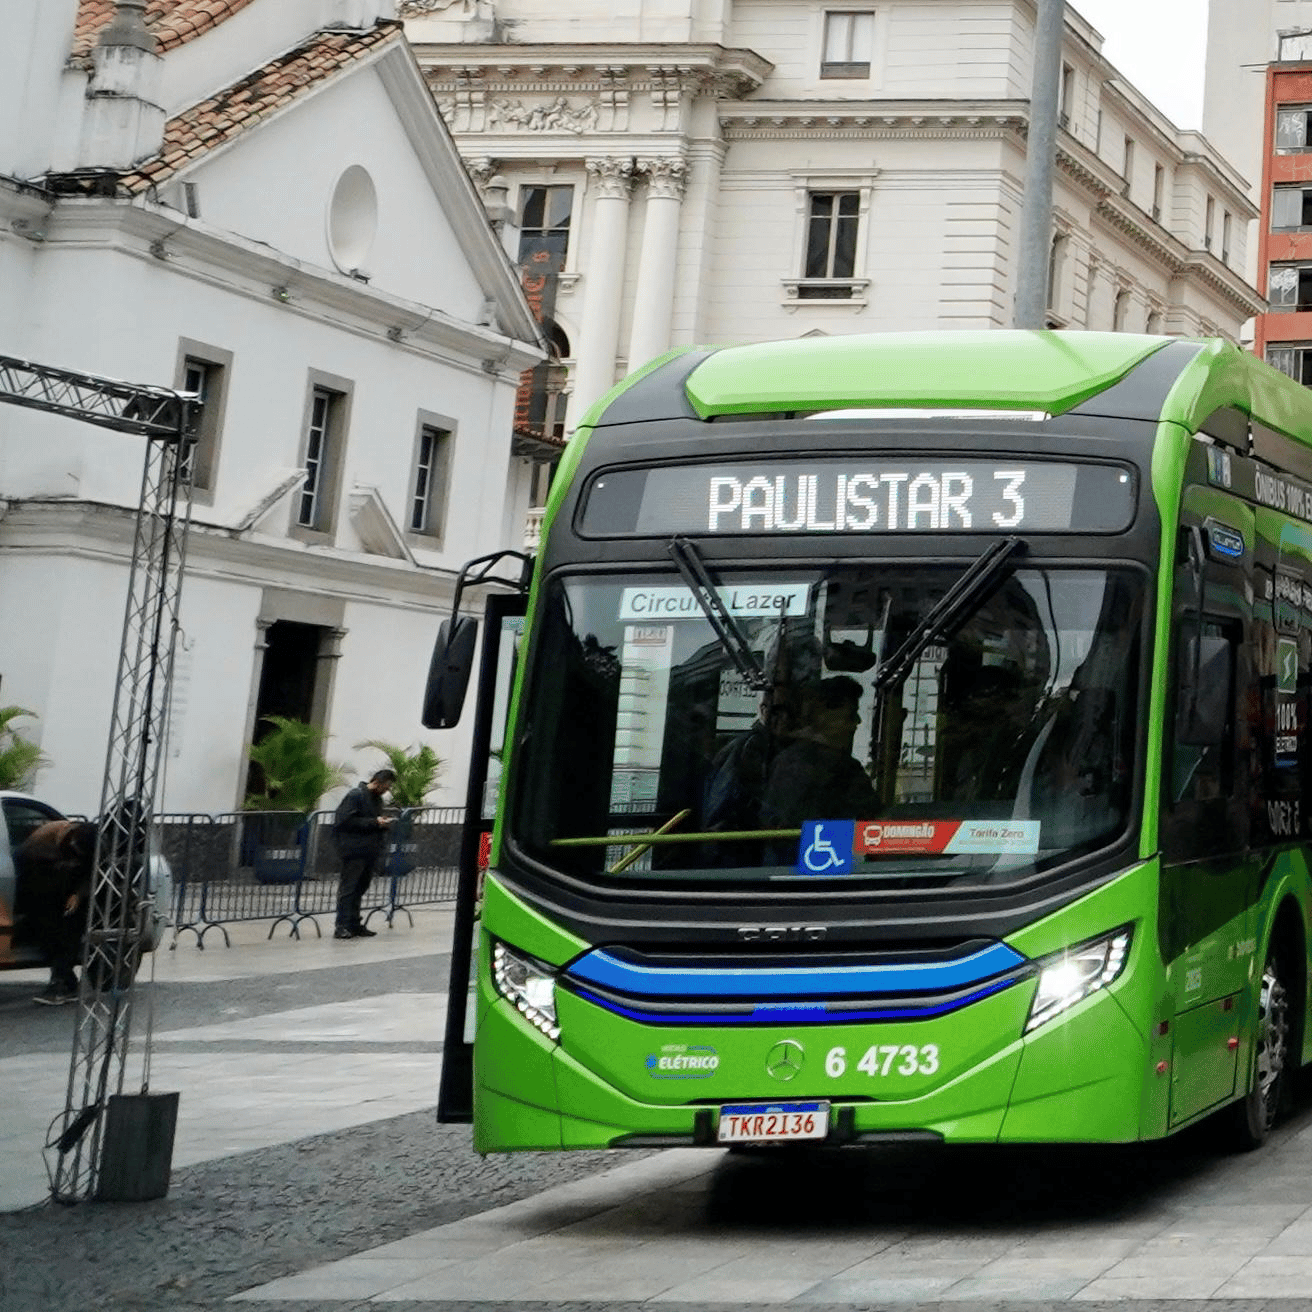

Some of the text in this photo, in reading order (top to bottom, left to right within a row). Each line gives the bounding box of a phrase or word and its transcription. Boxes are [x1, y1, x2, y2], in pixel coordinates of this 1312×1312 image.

[708, 471, 1026, 530] PAULISTAR 3
[731, 591, 797, 610] Lazer
[658, 1054, 719, 1070] ELÉTRICO
[825, 1043, 940, 1079] 6 4733
